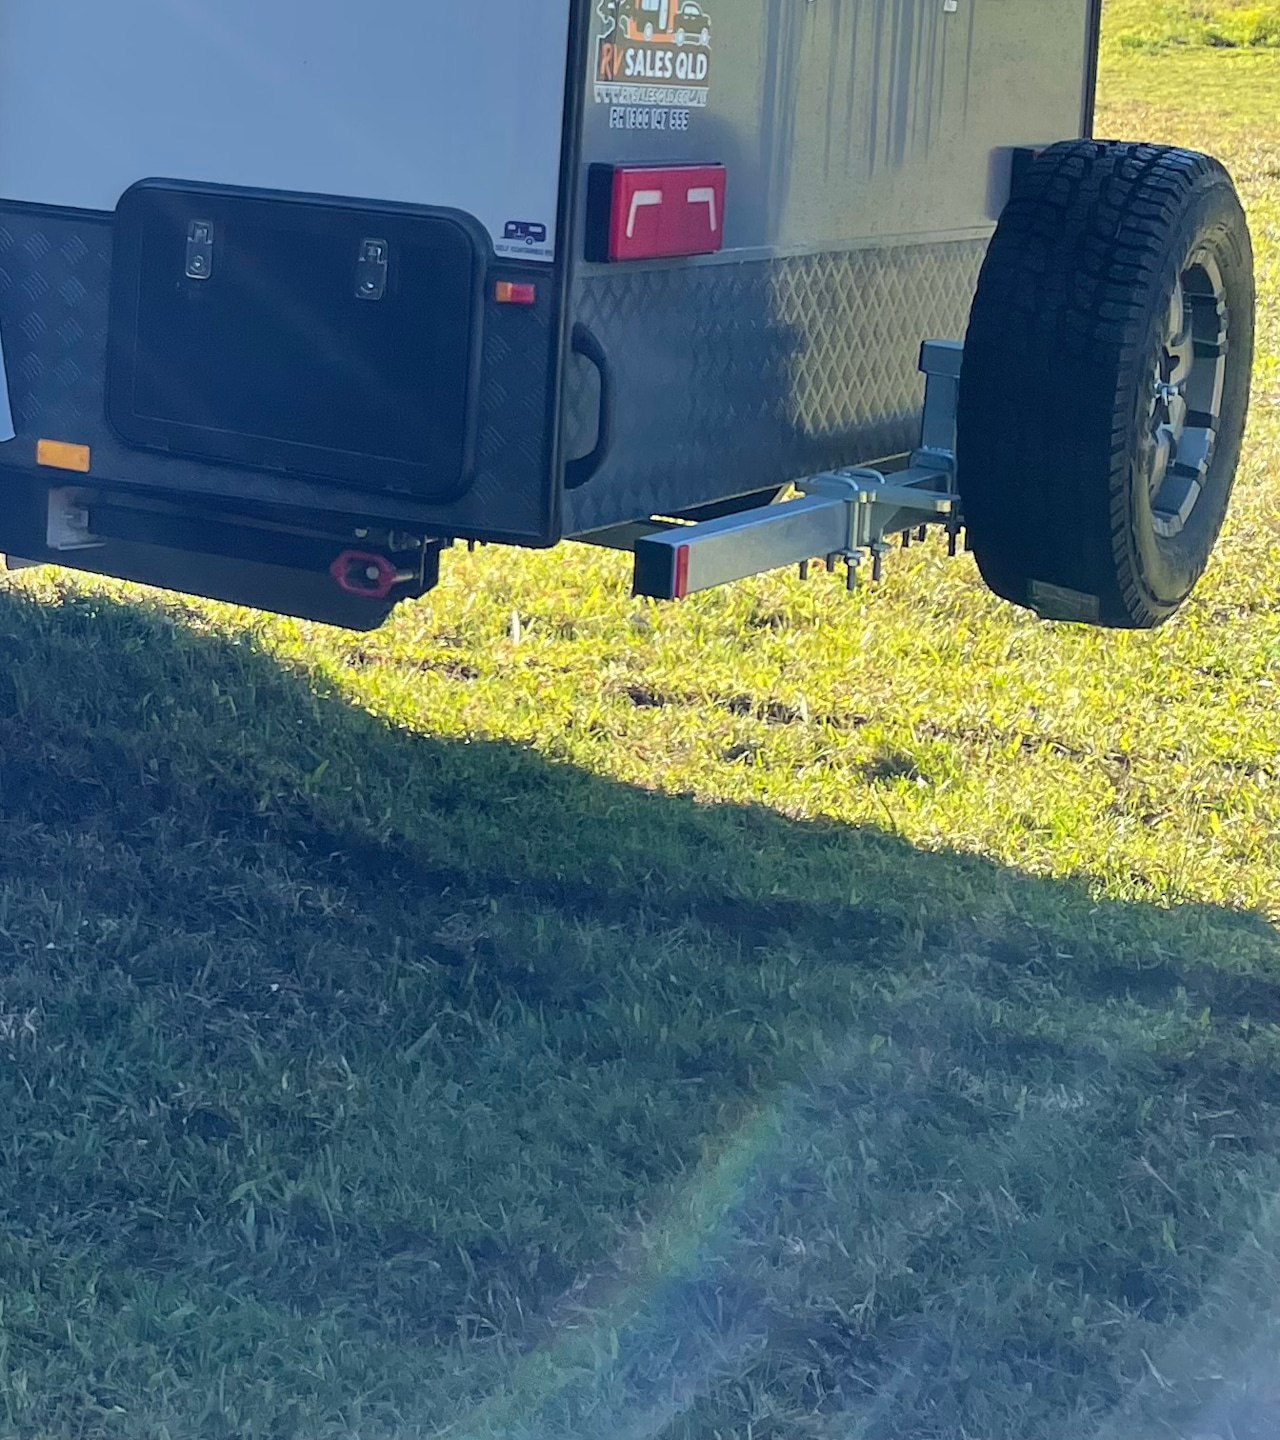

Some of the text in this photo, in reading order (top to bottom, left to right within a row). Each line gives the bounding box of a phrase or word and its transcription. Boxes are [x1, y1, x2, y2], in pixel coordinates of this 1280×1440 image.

[600, 42, 708, 81] RV SALES QLD
